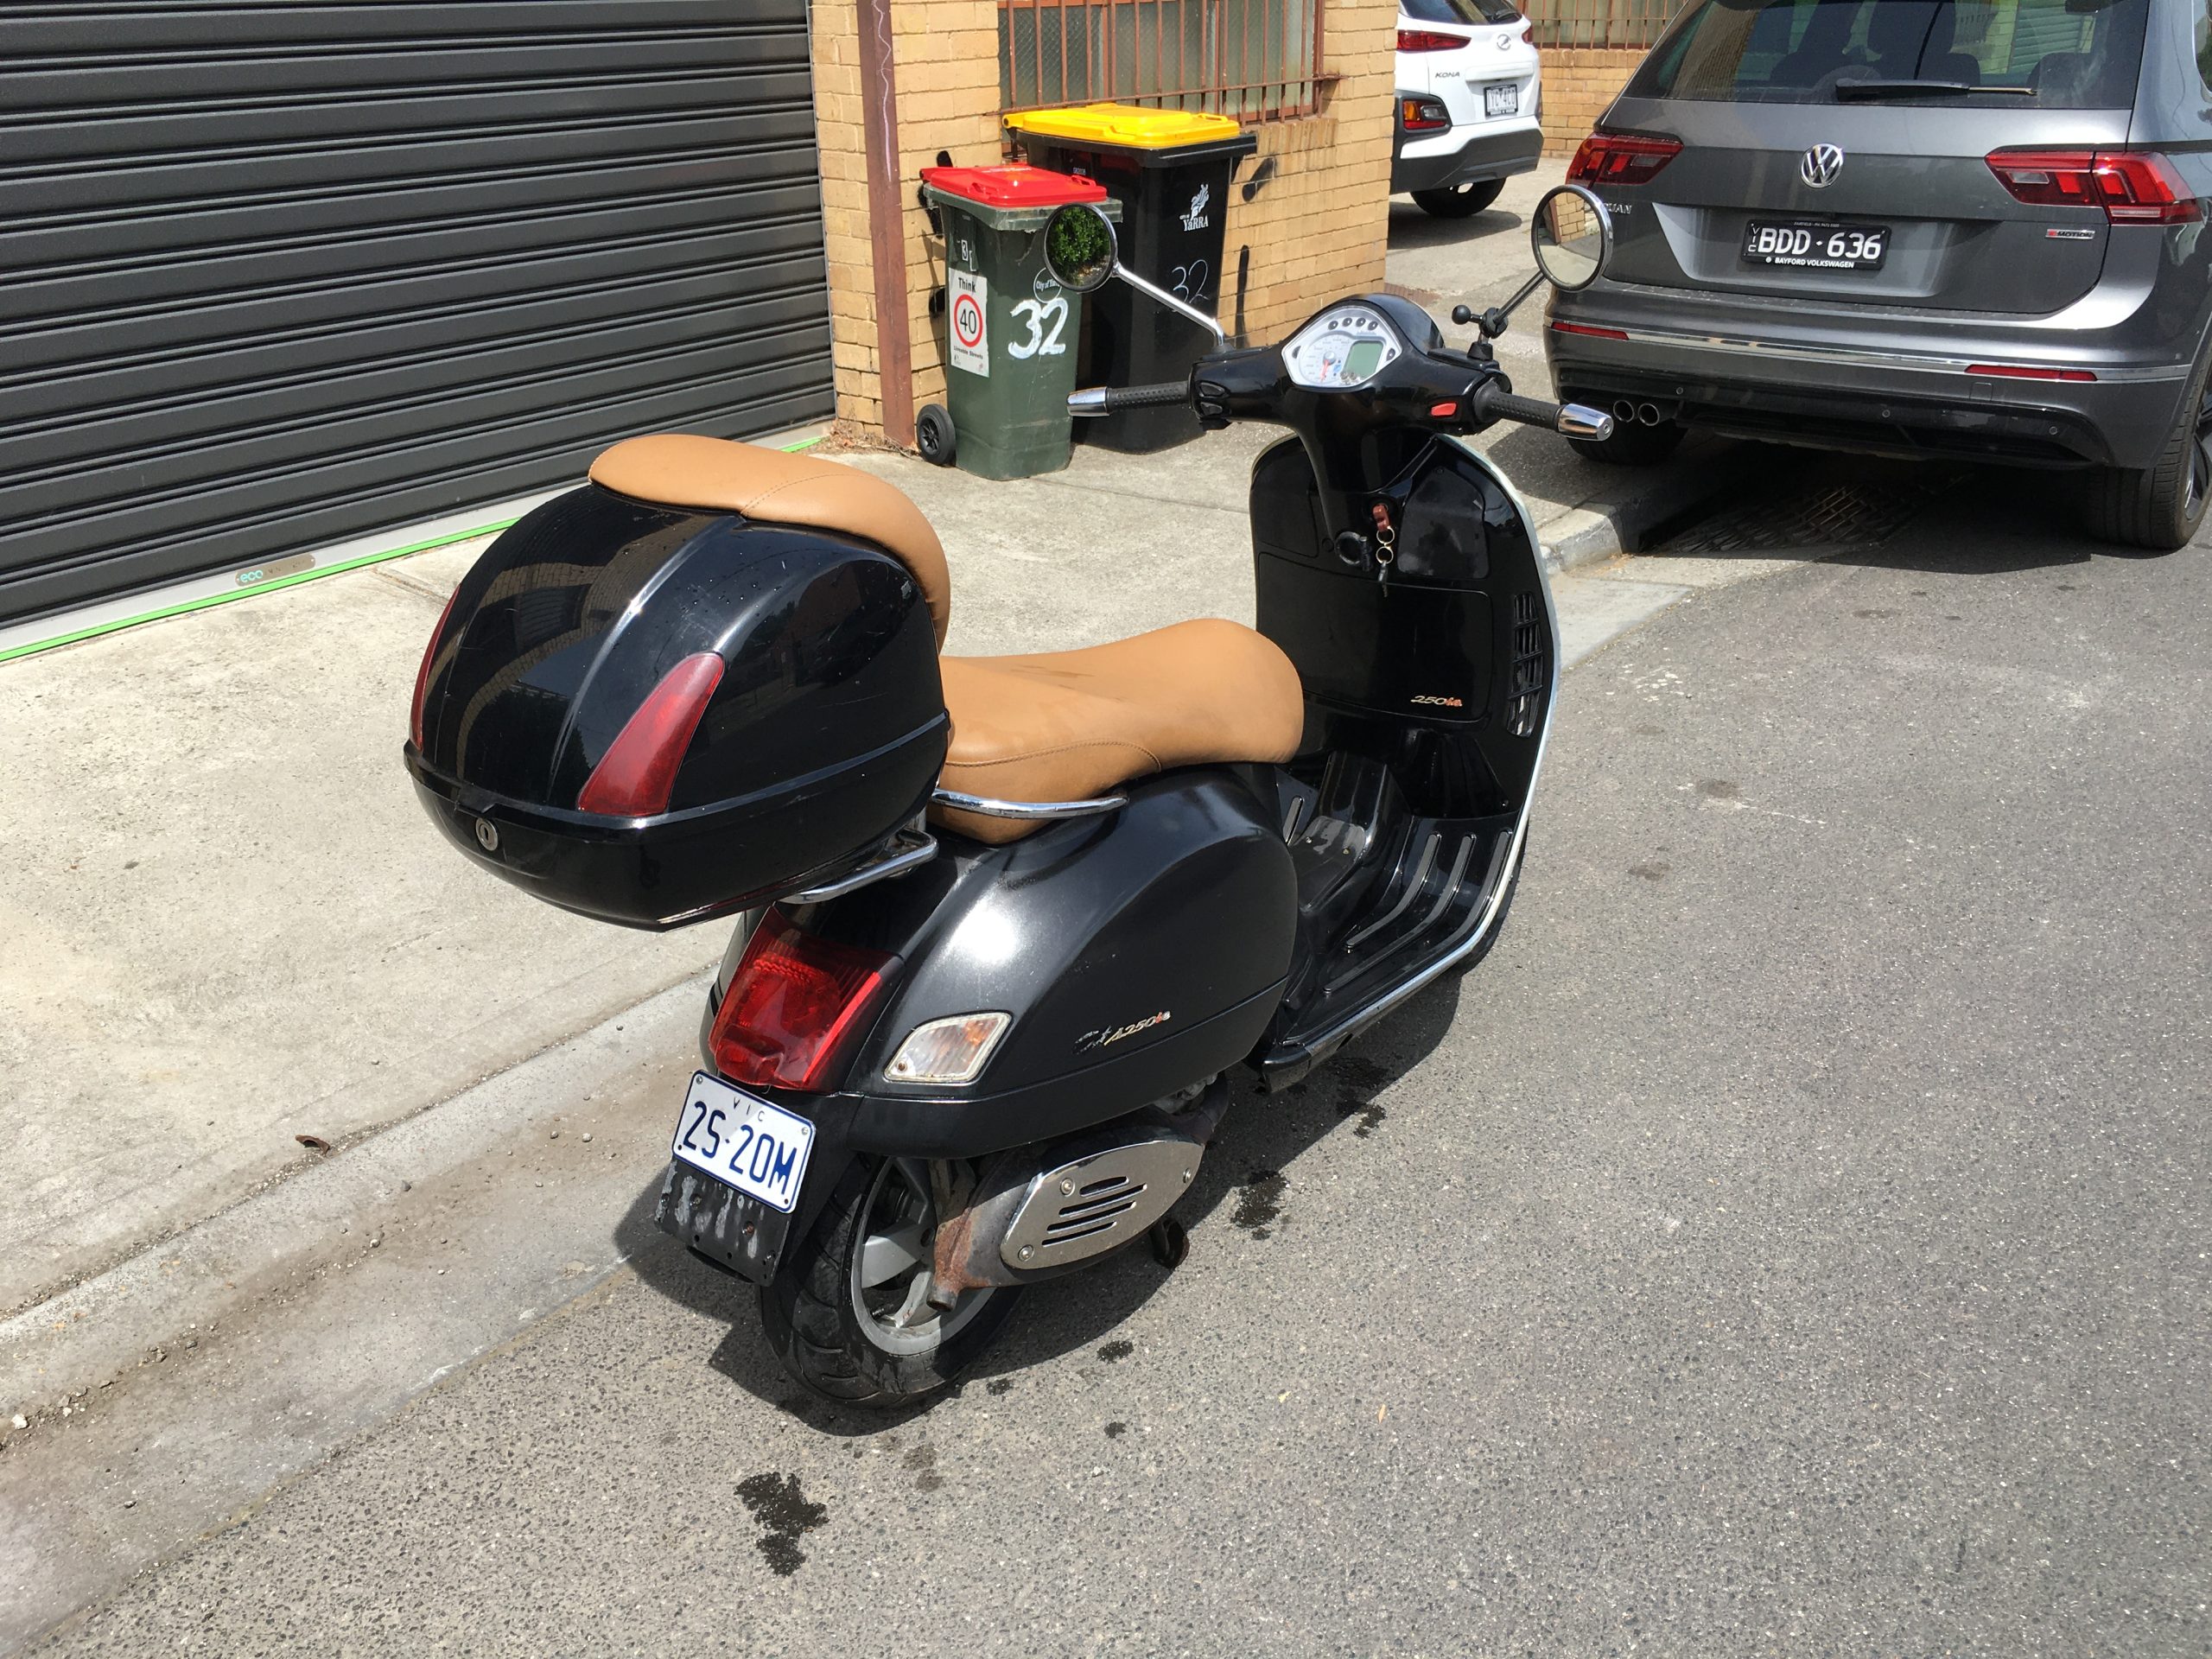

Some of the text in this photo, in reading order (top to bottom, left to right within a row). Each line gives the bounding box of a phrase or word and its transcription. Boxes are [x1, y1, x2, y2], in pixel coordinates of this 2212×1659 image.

[1775, 257, 1855, 268] BAYFORD VOLKSWAGEN
[958, 277, 976, 293] Think
[960, 308, 976, 334] 40
[1008, 297, 1068, 359] 32
[240, 570, 263, 582] eco
